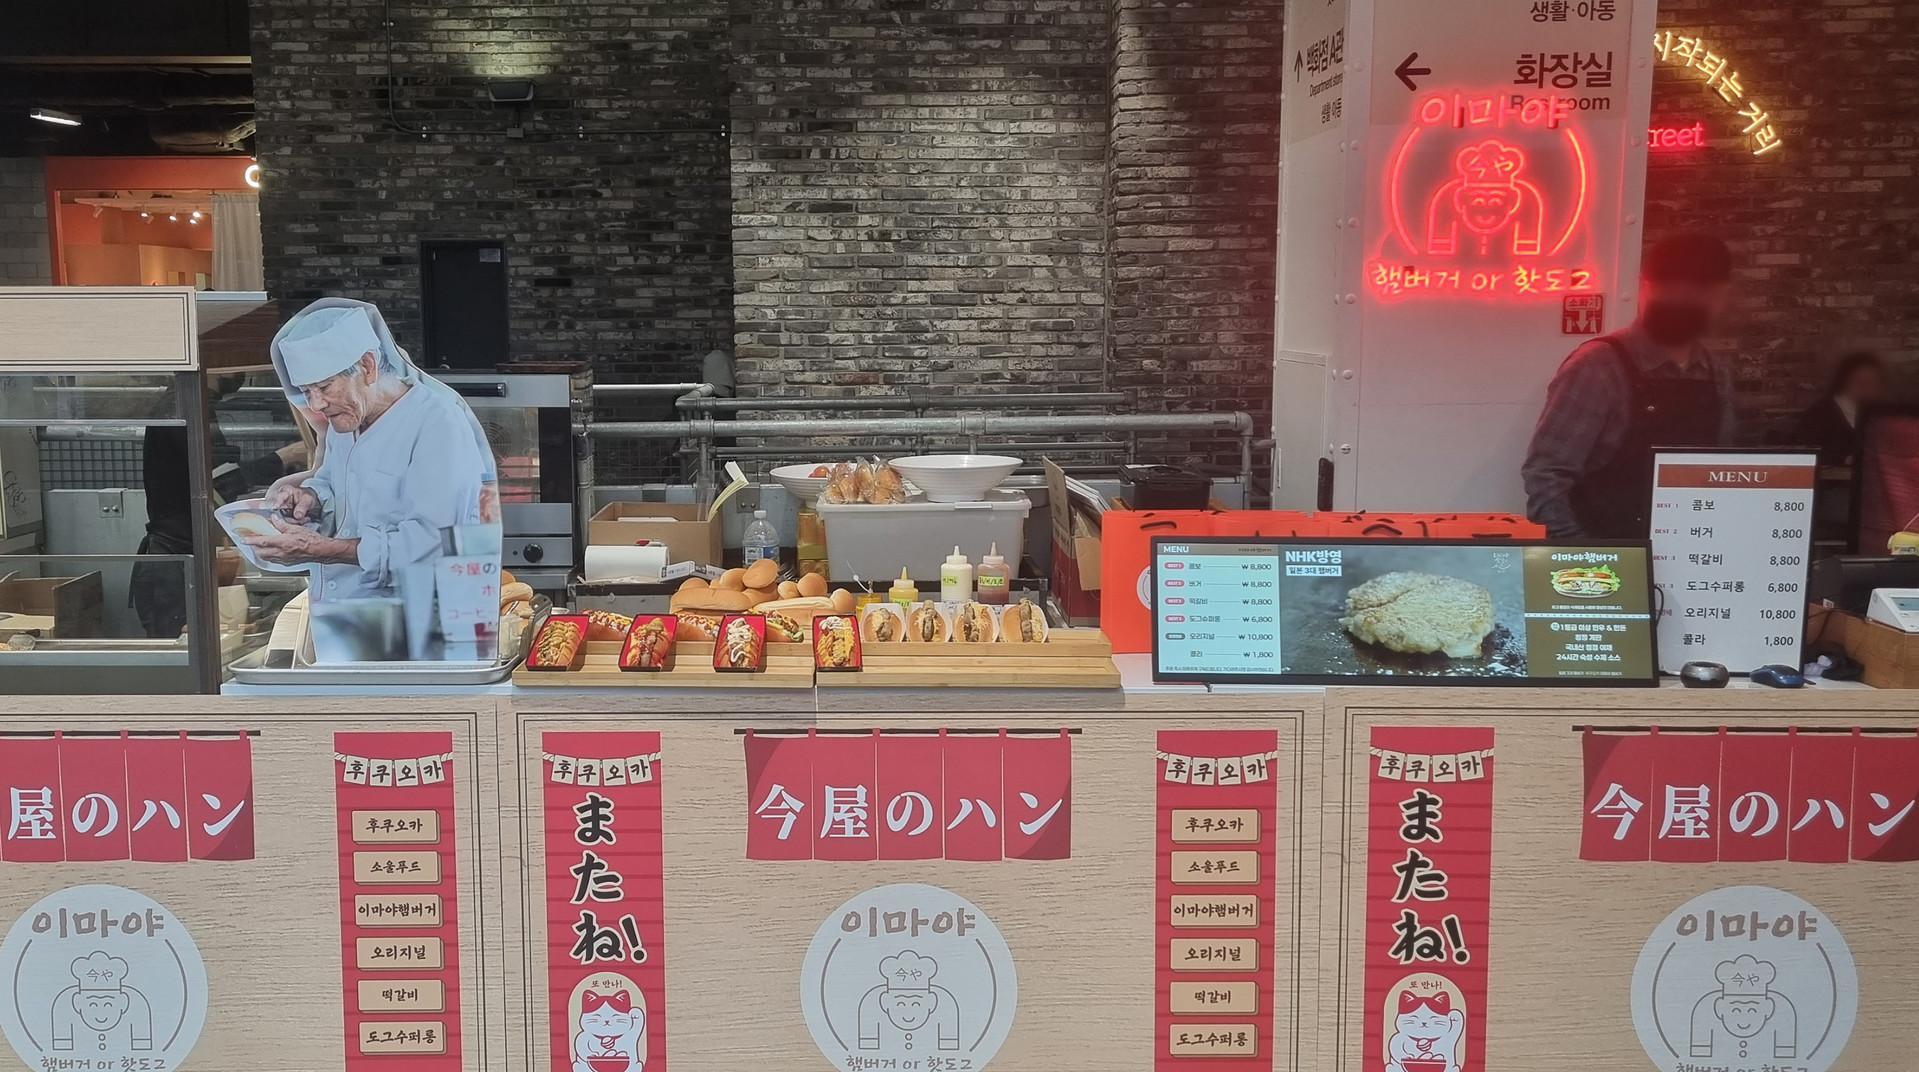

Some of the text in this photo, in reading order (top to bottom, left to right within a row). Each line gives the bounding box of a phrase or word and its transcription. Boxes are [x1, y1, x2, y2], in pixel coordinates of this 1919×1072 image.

[1530, 0, 1616, 22] 생활·아동
[1513, 52, 1613, 89] 화장실
[1310, 76, 1333, 98] Department
[1653, 30, 1783, 155] 시작되는 거리
[1511, 94, 1611, 111] Rroom
[1420, 94, 1570, 129] 이마야
[1648, 121, 1705, 148] reet
[1467, 155, 1514, 178] 今や
[1374, 263, 1592, 295] 햄버거 or 핫도그
[1568, 298, 1599, 307] 소화기
[1708, 471, 1768, 483] MENU
[1692, 500, 1715, 511] 콤보
[1774, 502, 1805, 513] 8,800
[1690, 527, 1713, 538] 버거
[1772, 529, 1803, 540] 8,800
[1285, 550, 1342, 564] NHK방영
[1688, 553, 1723, 565] 떡갈비
[1769, 556, 1800, 567] 8,800
[1289, 567, 1303, 575] 일본
[1686, 581, 1745, 593] 도그수퍼롱
[1767, 583, 1798, 594] 6,800
[1684, 607, 1731, 619] 오리지널
[1759, 609, 1796, 620] 10,800
[1682, 634, 1794, 647] 콜라 1,800
[347, 759, 442, 784] 후쿠오카
[553, 758, 649, 783] 후쿠오카
[1167, 757, 1266, 781] 후쿠오카
[1380, 754, 1481, 779] 후쿠오카
[7, 785, 245, 841] 屋のハン
[754, 783, 1063, 841] 今屋のハン
[1591, 783, 1916, 841] 今屋のハン
[365, 817, 423, 834] 후쿠오카
[1184, 816, 1245, 833] 후쿠오카
[369, 859, 422, 874] 소울푸드
[1186, 859, 1241, 874] 소울푸드
[571, 793, 648, 964] またね!
[1388, 788, 1471, 964] またね!
[357, 902, 437, 919] 이마야햄버거
[1173, 902, 1254, 919] 이마야햄버거
[31, 908, 165, 938] 이마야
[840, 906, 977, 938] 이마야
[1676, 909, 1818, 942] 이마야
[369, 945, 427, 962] 오리지널
[1183, 945, 1242, 962] 오리지널
[86, 968, 114, 984] 今や
[590, 978, 623, 989] 또 만나!
[894, 968, 923, 982] 今や
[1731, 972, 1760, 987] 今や
[1409, 980, 1443, 990] 또 만나!
[381, 988, 419, 1003] 떡갈비
[1194, 989, 1232, 1005] 떡갈비
[365, 1028, 437, 1046] 도그수퍼롱
[1175, 1030, 1249, 1048] 도그수퍼롱
[40, 1056, 166, 1072] 햄버거 or 핫도그
[845, 1055, 973, 1072] 햄버거 or 핫도그
